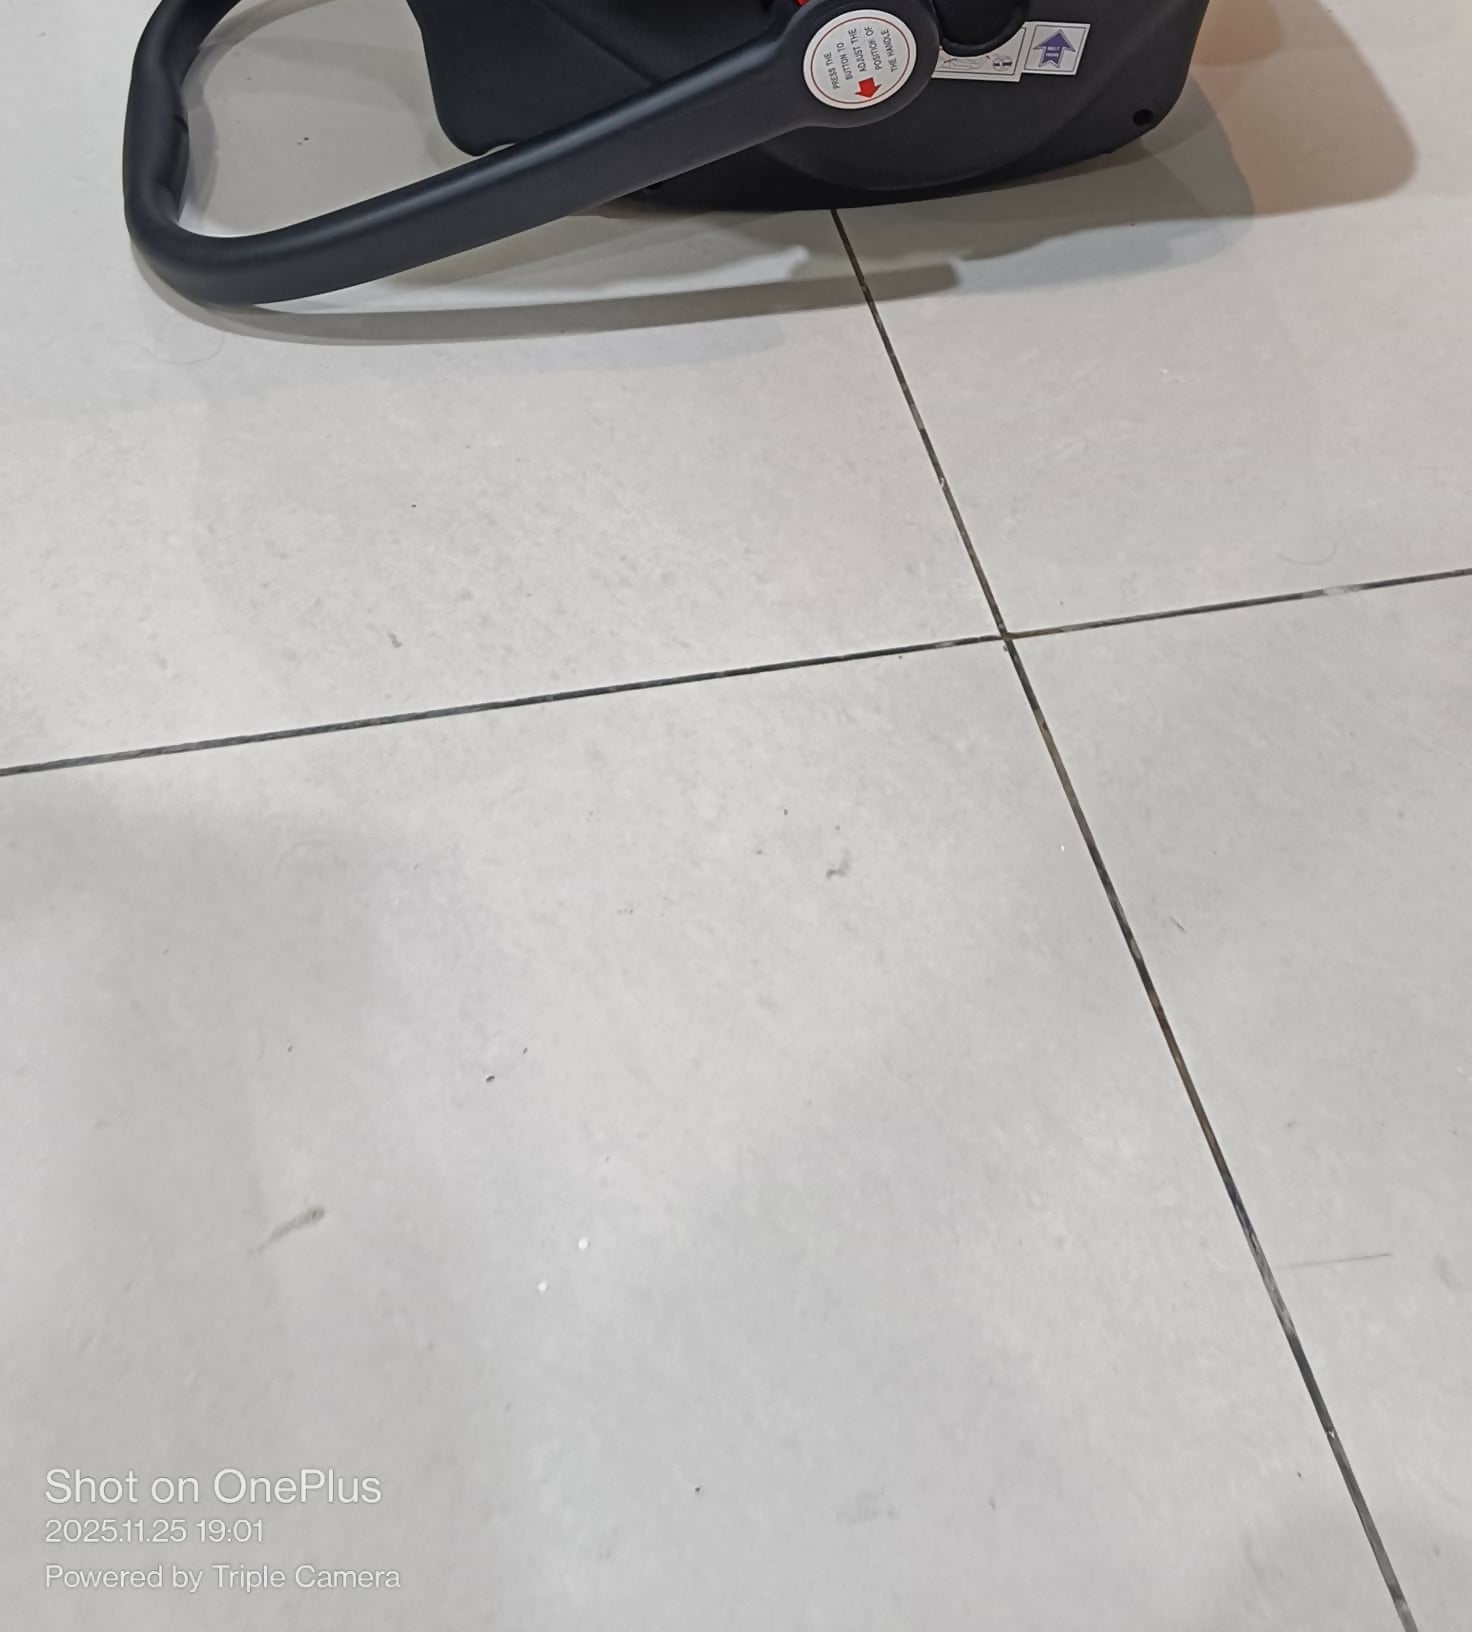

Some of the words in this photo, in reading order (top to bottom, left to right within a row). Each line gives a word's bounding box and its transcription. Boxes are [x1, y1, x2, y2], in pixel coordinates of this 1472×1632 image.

[848, 28, 858, 44] THE
[864, 26, 874, 37] OF
[836, 42, 844, 52] TO
[881, 29, 895, 57] HANDLE
[823, 52, 833, 66] THE
[852, 46, 867, 72] ADJUST
[868, 38, 883, 70] POSITION
[839, 53, 853, 80] BUTTON
[888, 58, 898, 73] THE
[828, 67, 840, 90] PRESS
